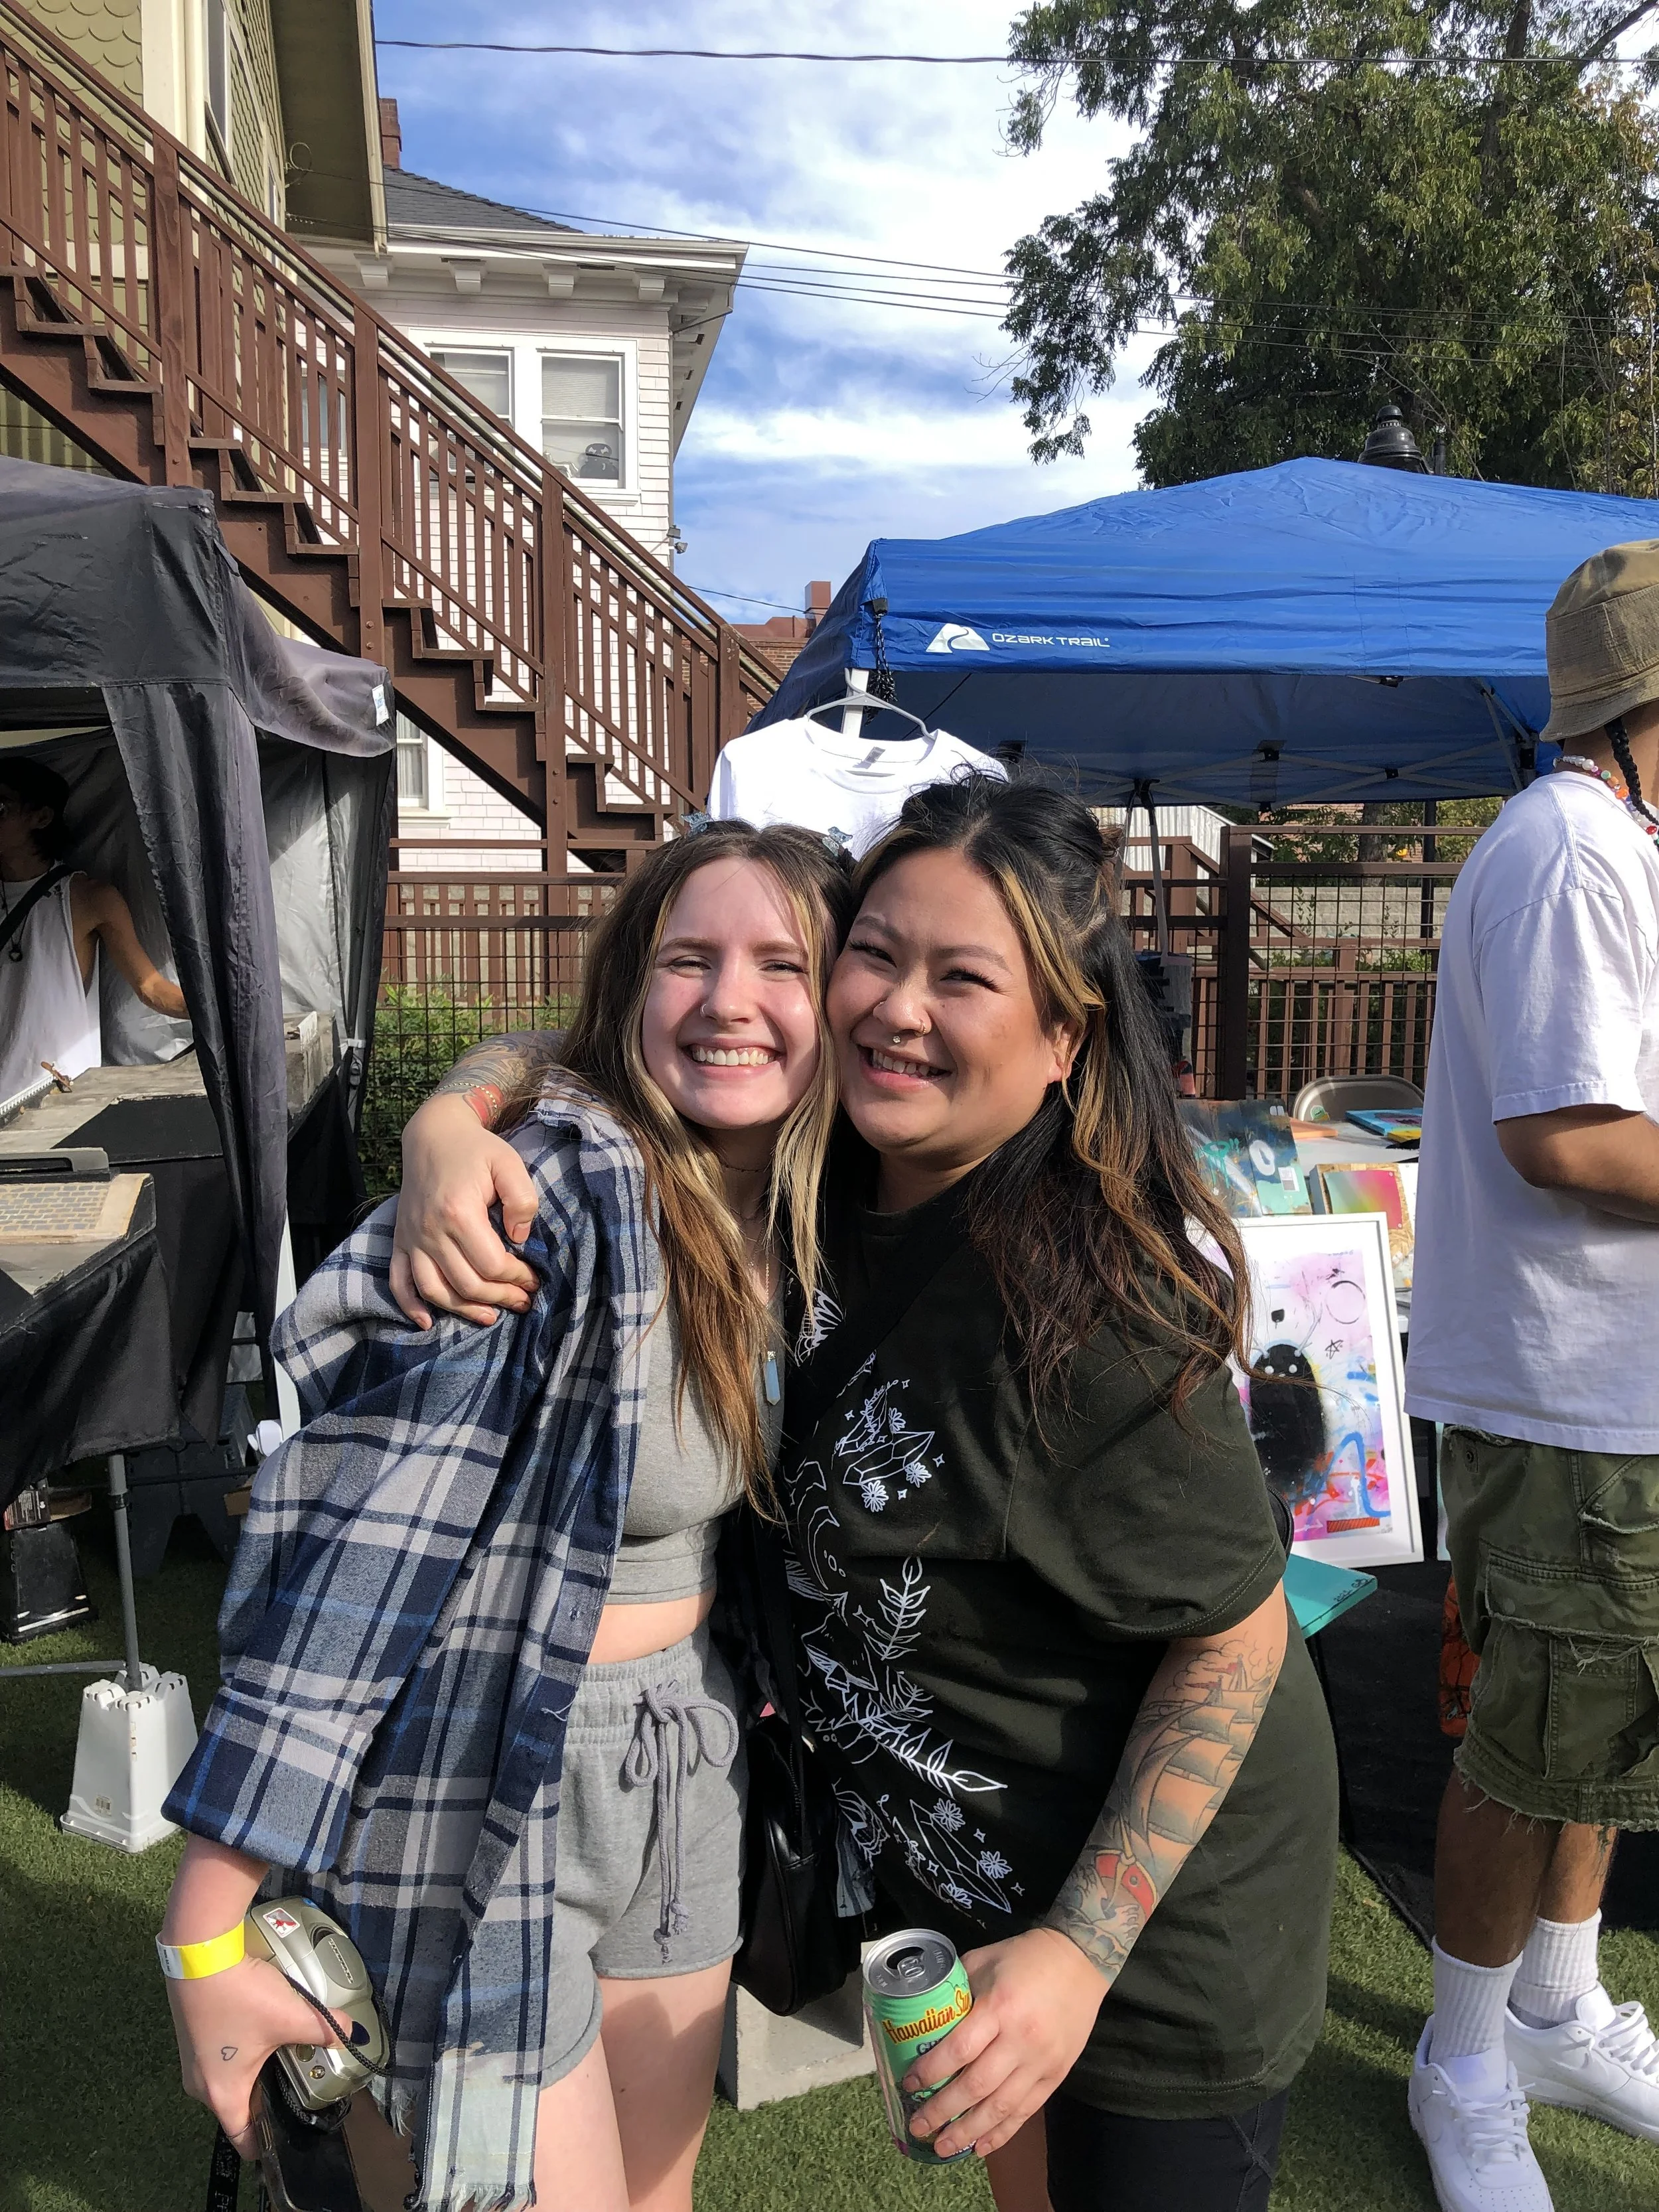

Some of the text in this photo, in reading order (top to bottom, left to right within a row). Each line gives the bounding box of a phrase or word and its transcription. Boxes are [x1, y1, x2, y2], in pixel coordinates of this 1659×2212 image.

[992, 633, 1110, 647] OZARK TRAIL
[882, 2006, 956, 2044] Hawaiian
